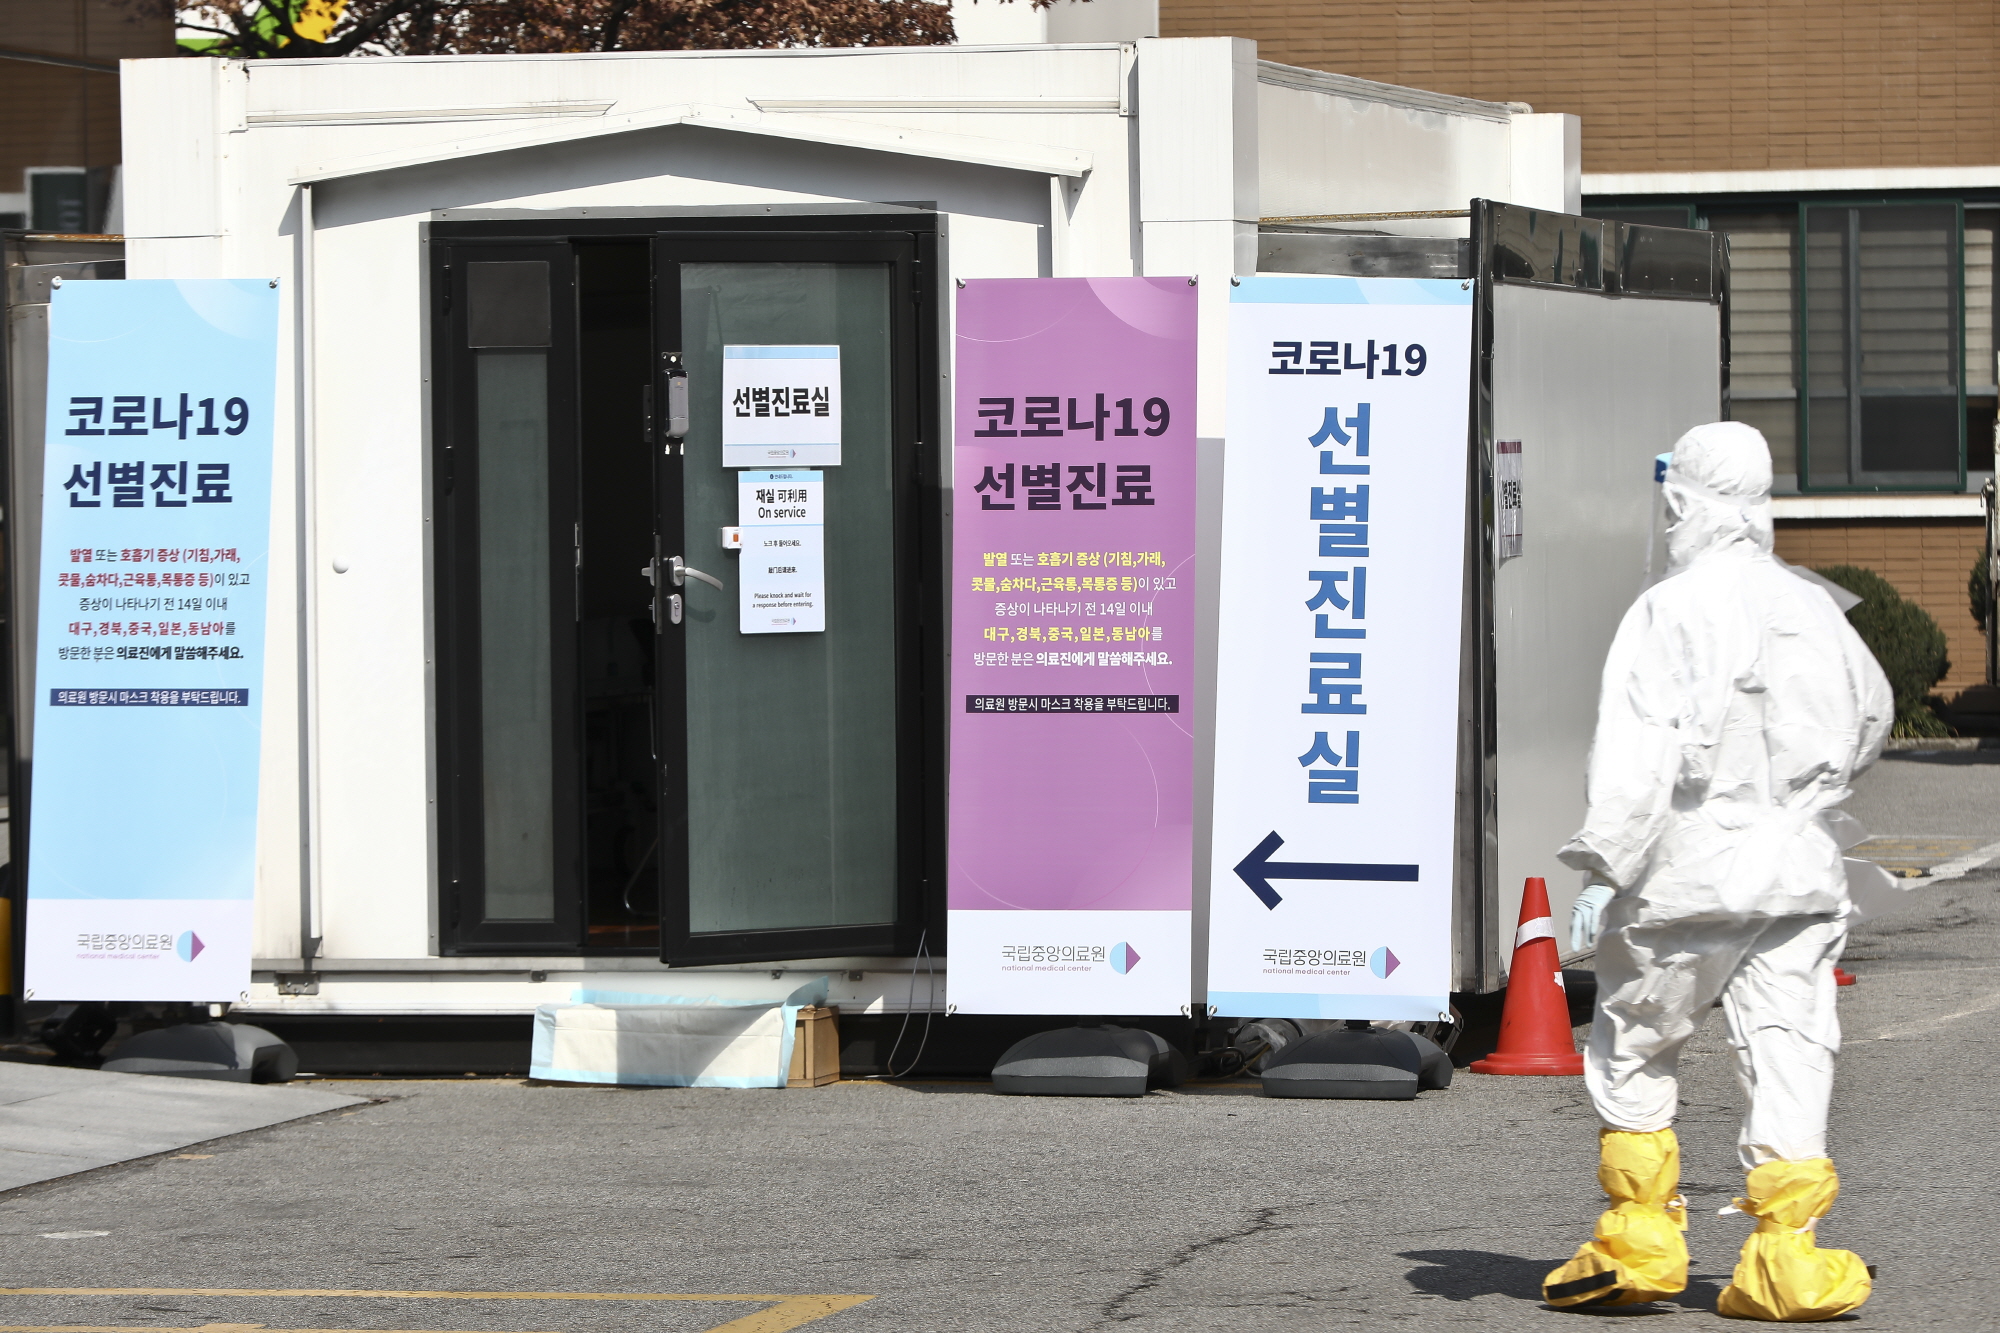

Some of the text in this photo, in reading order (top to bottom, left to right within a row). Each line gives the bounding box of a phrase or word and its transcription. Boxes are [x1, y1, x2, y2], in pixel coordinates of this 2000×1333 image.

[1268, 339, 1428, 380] 코로나19
[733, 386, 830, 417] 선별진료실
[64, 393, 249, 440] 코로나19
[974, 393, 1171, 441] 코로나19
[64, 461, 232, 508] 선별진료
[973, 463, 1155, 510] 선별진료
[756, 489, 807, 503] 재실 可利用
[758, 506, 806, 518] On service
[70, 548, 240, 563] 발열 또는 호흡기 증상 (기침,가래,
[983, 552, 1166, 568] 발열 또는 호흡기 증상 (기침,가래,
[58, 573, 250, 588] 콧물,숨차다,근육통,목통증 등)이 있고
[971, 577, 1176, 593] 콧물,숨차다,근육통,목통증 등)이 있고
[80, 597, 227, 611] 증상이 나타나기 전 14일 이내
[995, 602, 1153, 616] 증상이 나타나기 전 14일 이내
[1297, 402, 1372, 804] 선별진료실
[69, 622, 236, 637] 대구,경북,중국,일본,동남아를
[984, 627, 1163, 643] 대구,경북,중국,일본,동남아를
[59, 646, 244, 660] 방문한 분은 의료진에게 말씀해주세요.
[974, 652, 1173, 666] 방문한 분은 의료진에게 말씀해주세요.
[58, 691, 241, 704] 의료원 방문시 마스크 착용을 부탁드립니다.
[975, 698, 1170, 711] 의료원 방문시 마스크 착용을 부탁드립니다.
[77, 934, 173, 950] 국립중앙의료원
[1002, 946, 1105, 962] 국립중앙의료원
[1263, 949, 1366, 966] 국립중앙의료원
